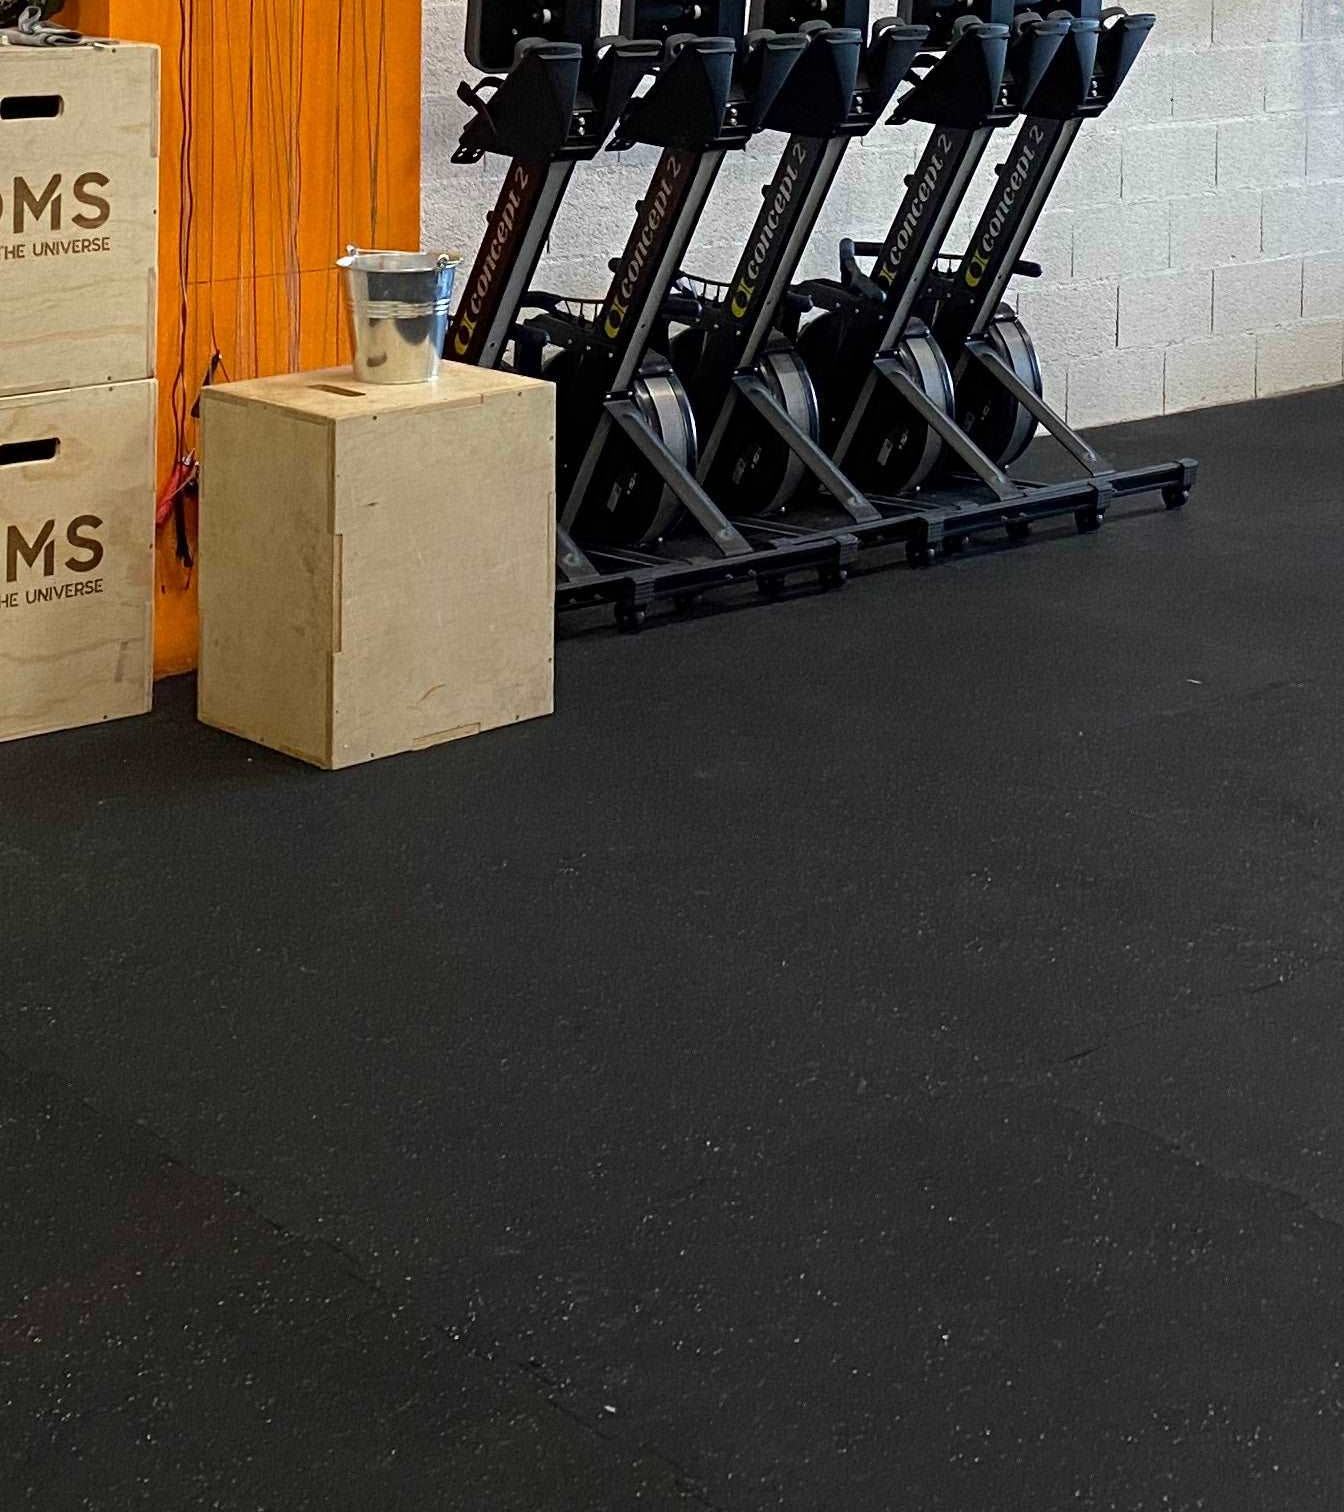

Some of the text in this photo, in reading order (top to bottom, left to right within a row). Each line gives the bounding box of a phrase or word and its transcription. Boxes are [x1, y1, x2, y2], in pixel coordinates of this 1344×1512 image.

[32, 237, 110, 256] UNIVERSE
[470, 167, 529, 316] concept 2
[621, 158, 682, 300] concept 2
[747, 143, 807, 279] concept 2
[890, 133, 953, 267] concept 2
[982, 124, 1044, 252] concept 2
[25, 578, 103, 604] UNIVERSE
